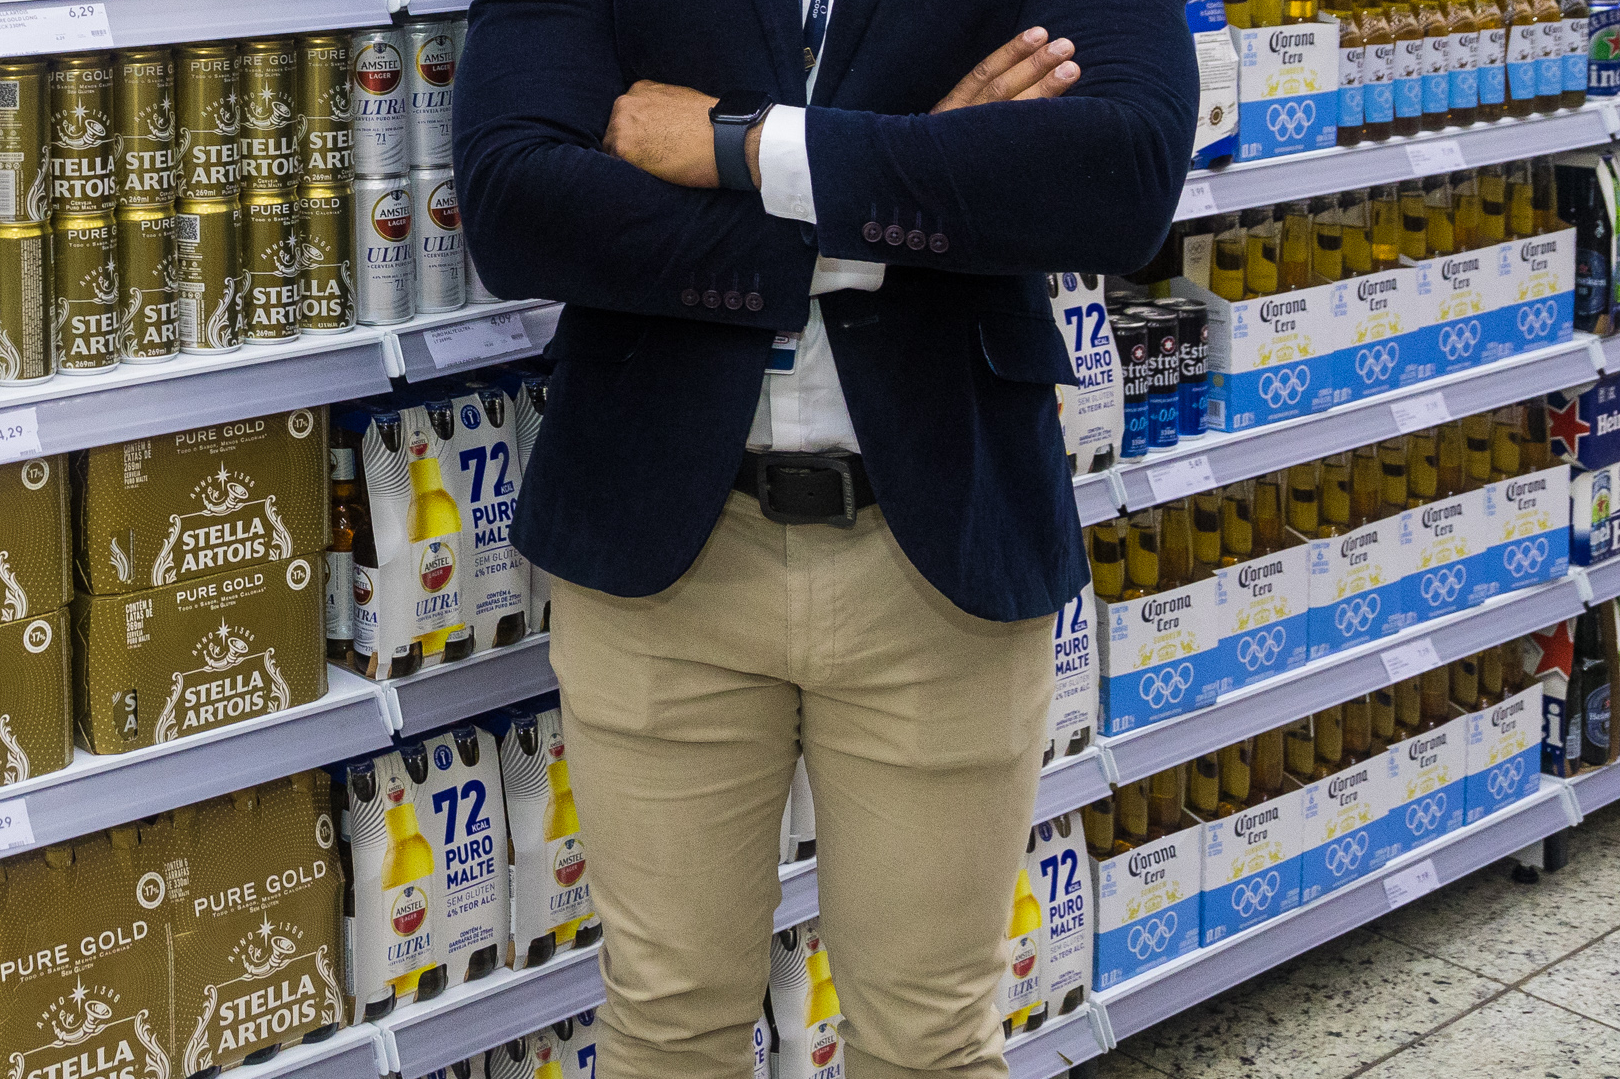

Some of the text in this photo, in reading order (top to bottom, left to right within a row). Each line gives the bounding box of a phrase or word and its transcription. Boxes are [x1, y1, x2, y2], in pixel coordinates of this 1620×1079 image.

[68, 5, 95, 19] 6,29
[1268, 31, 1315, 54] Corona
[122, 64, 164, 77] PURE
[360, 58, 401, 70] AMSTEL
[1282, 48, 1303, 66] Cero
[375, 132, 386, 144] 71
[128, 194, 149, 204] 269ml
[1442, 257, 1480, 281] Corona
[1357, 276, 1398, 303] Corona
[1260, 298, 1308, 324] Corona
[1275, 314, 1297, 333] Cero
[1064, 303, 1108, 353] 72
[1075, 349, 1112, 373] PURO
[1078, 369, 1114, 390] MALTE
[175, 420, 265, 447] PURE GOLD
[458, 440, 512, 504] 72
[1421, 501, 1463, 531] Corona
[182, 517, 266, 551] STELLA
[180, 538, 266, 573] ARTOIS
[1141, 593, 1192, 625] Corona
[1157, 615, 1180, 633] Cero
[184, 670, 264, 707] STELLA
[181, 690, 265, 730] ARTOIS
[432, 778, 488, 846] 72
[471, 820, 490, 833] KCAL
[445, 835, 494, 870] PURO
[1128, 842, 1177, 878] Corona
[446, 857, 495, 890] MALTE
[1144, 866, 1166, 885] Cero
[193, 859, 327, 918] PURE GOLD
[446, 881, 496, 908] SEM GLÚTEN
[395, 900, 423, 918] AMSTEL
[446, 893, 497, 918] 4% TEOR ALC.
[387, 932, 431, 962] ULTRA
[219, 974, 316, 1026] STELLA
[217, 999, 318, 1054] ARTOIS
